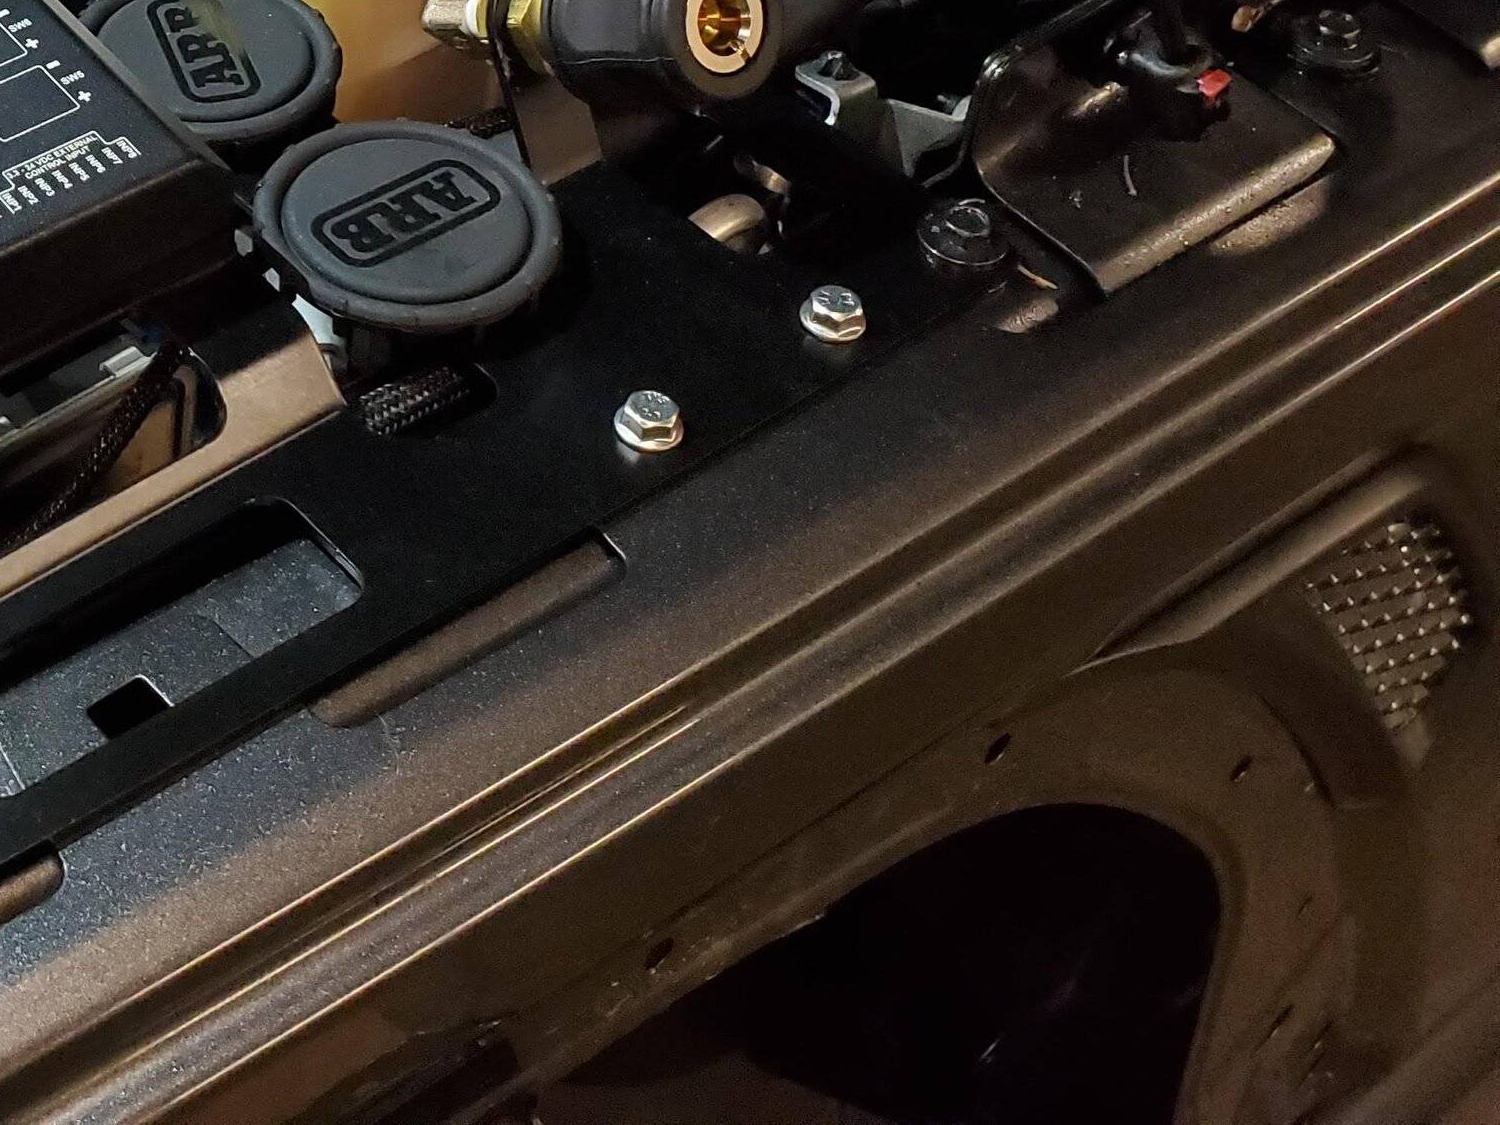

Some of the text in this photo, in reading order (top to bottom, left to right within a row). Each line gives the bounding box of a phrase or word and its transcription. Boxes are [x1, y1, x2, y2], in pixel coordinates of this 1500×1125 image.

[35, 154, 54, 166] VDC
[53, 135, 98, 157] EXTERNAL
[101, 146, 124, 165] INP7
[25, 145, 92, 180] CONTROL INPUT
[68, 162, 90, 182] INP5
[34, 177, 56, 197] INP3
[51, 170, 74, 189] INP4
[1, 192, 23, 212] INP1
[17, 185, 40, 205] INP2
[330, 171, 480, 255] ARB
